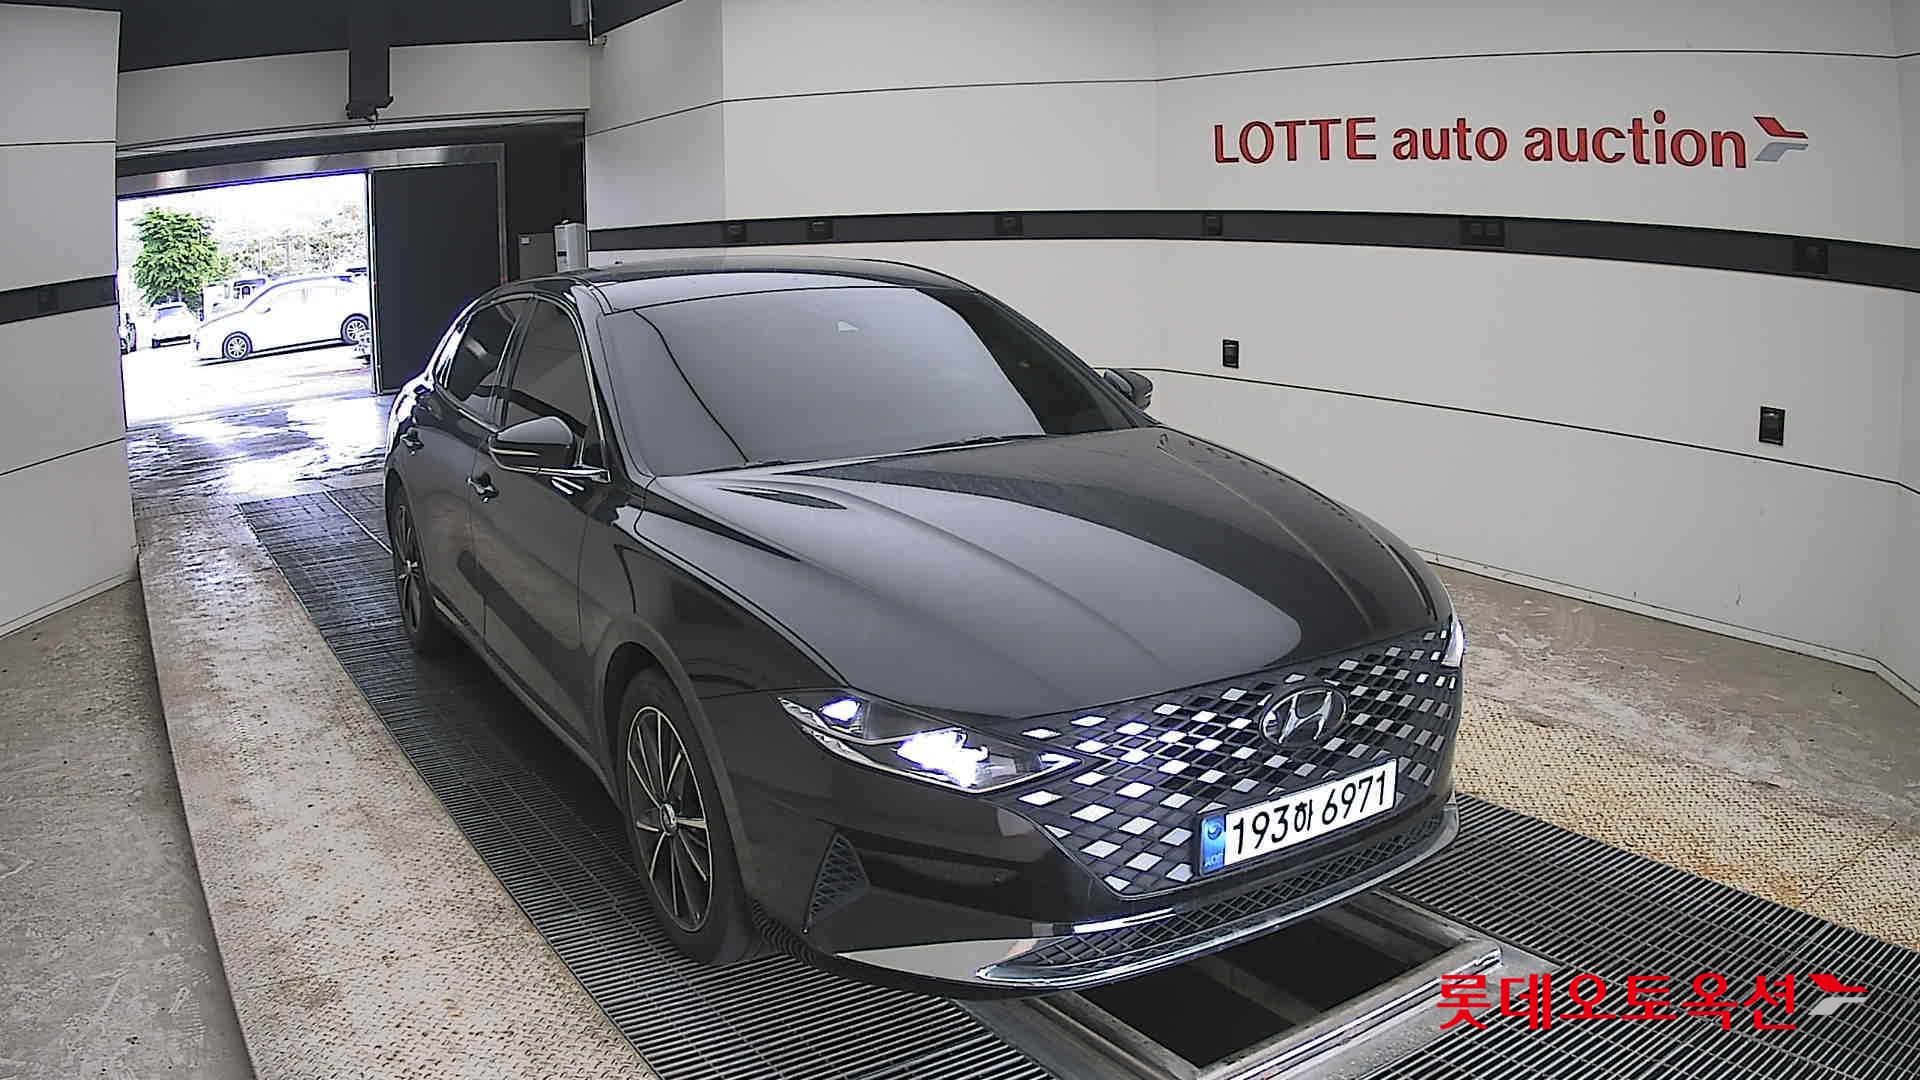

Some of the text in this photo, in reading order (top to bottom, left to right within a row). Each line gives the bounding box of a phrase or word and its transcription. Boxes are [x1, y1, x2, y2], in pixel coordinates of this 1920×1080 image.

[1214, 109, 1747, 169] LOTTE auto auction
[1233, 770, 1386, 855] 193하 6971
